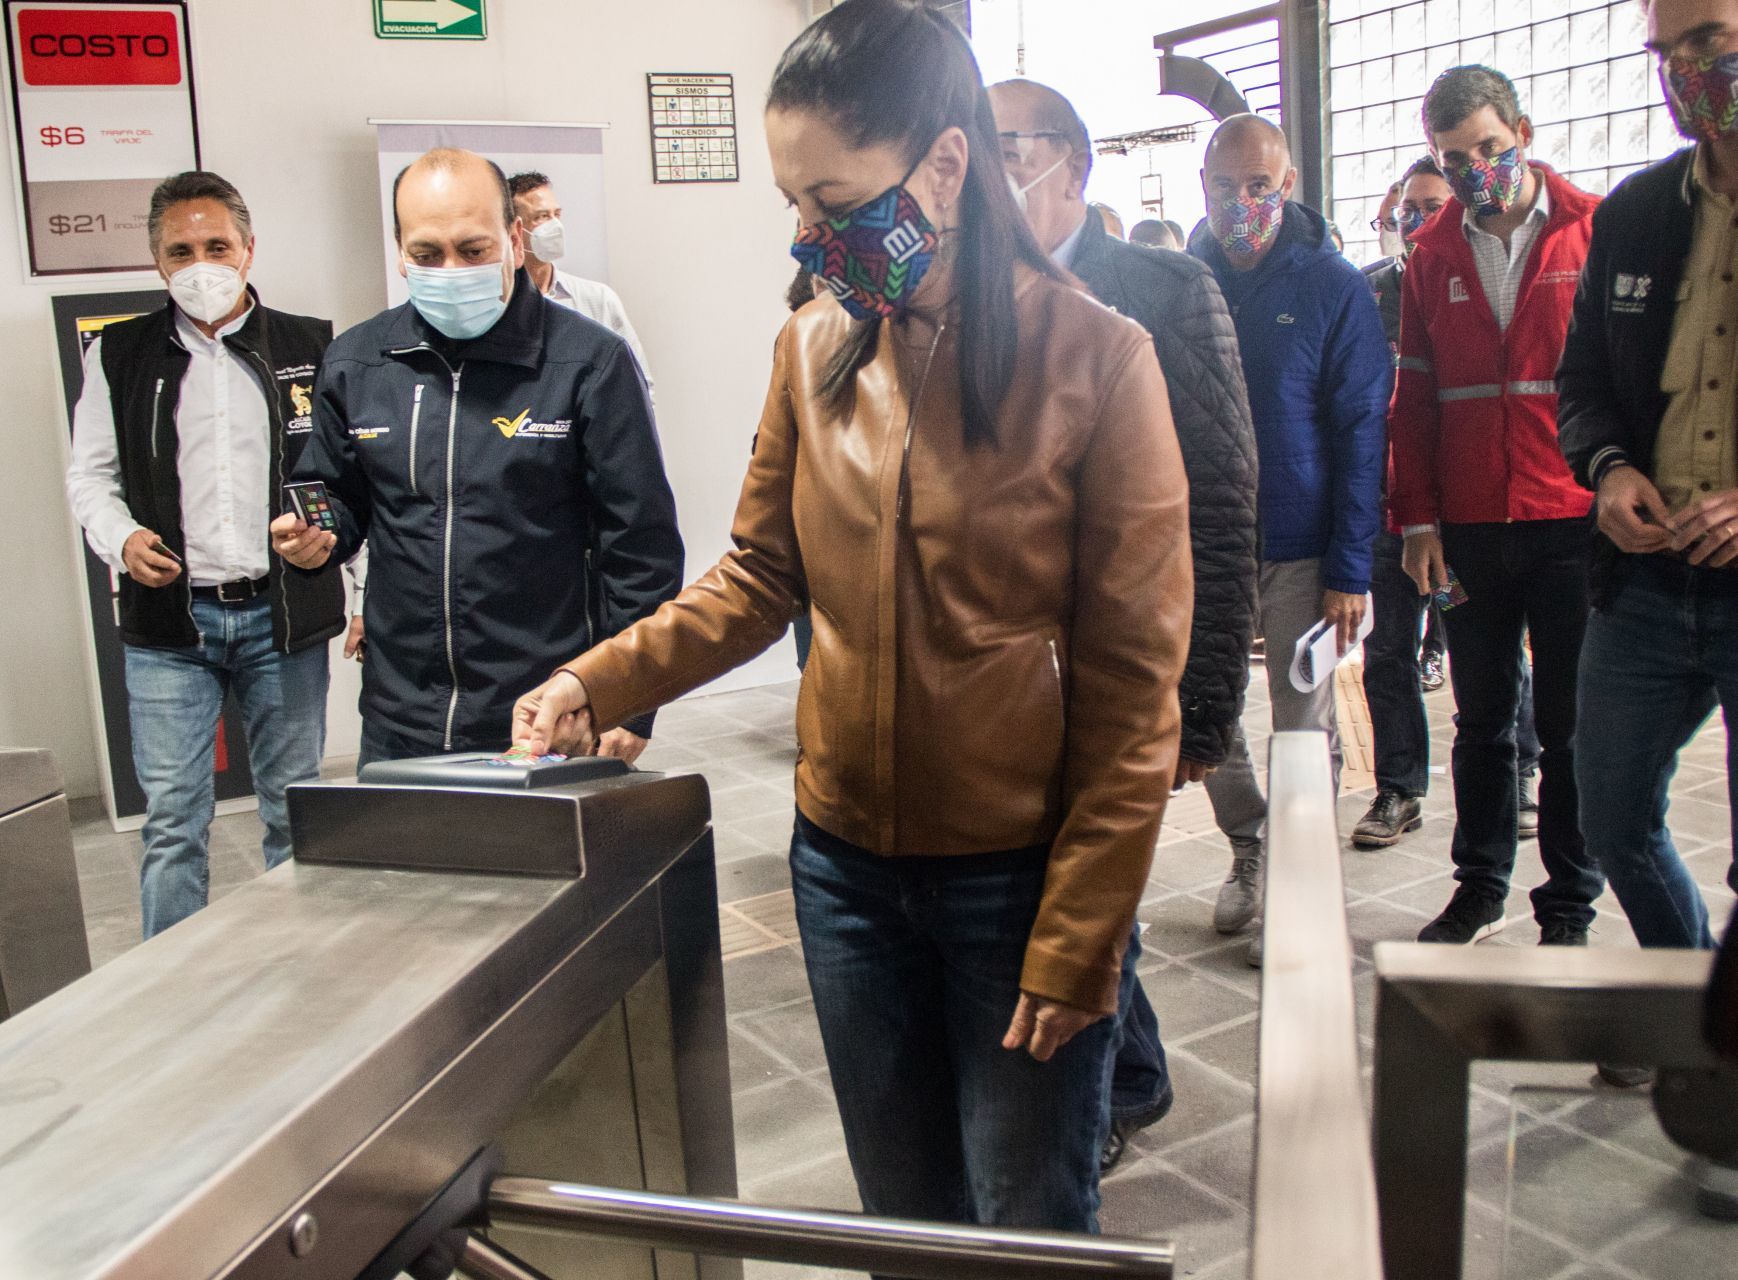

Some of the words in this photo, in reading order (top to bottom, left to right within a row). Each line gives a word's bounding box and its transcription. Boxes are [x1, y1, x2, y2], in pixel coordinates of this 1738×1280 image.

[383, 24, 437, 33] EVACUACIÓN
[30, 34, 169, 58] COSTO
[675, 87, 709, 95] SISMOS
[40, 125, 85, 147] $6
[672, 128, 717, 136] INCENDIOS
[49, 213, 107, 236] $21
[517, 417, 572, 433] Carranza
